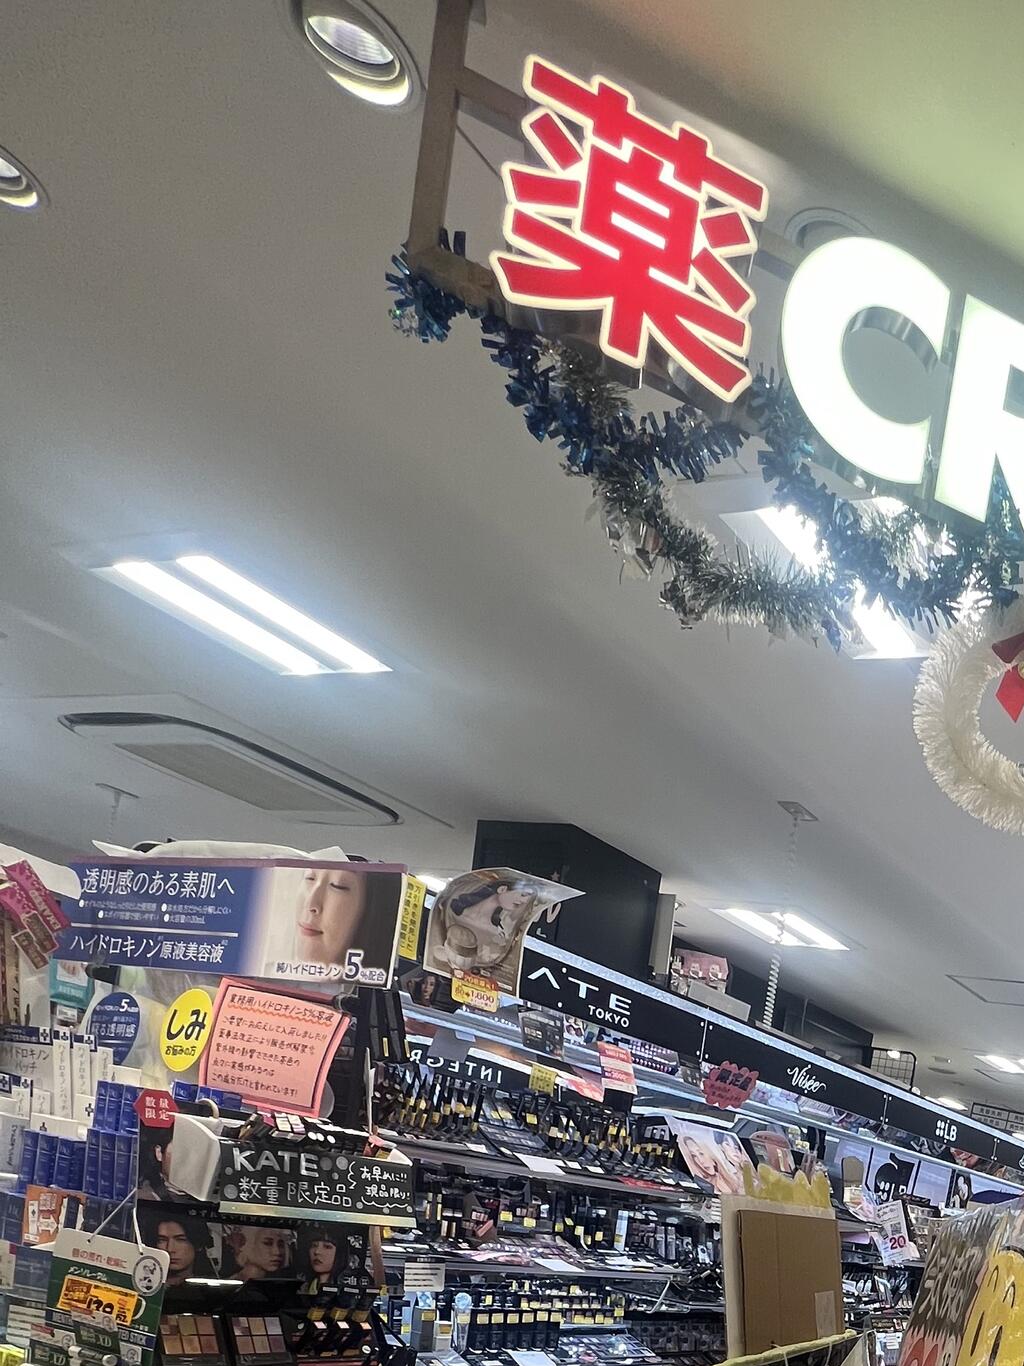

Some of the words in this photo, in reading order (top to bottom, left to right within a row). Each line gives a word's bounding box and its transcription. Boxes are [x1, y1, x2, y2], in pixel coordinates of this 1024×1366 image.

[491, 55, 768, 401] 薬
[82, 868, 235, 899] 透明感のある素肌へ
[167, 1009, 207, 1041] しみ
[588, 1004, 630, 1028] TOKYO
[232, 1147, 320, 1178] KATE
[239, 1175, 352, 1207] 数量限定品
[889, 1235, 906, 1250] 20
